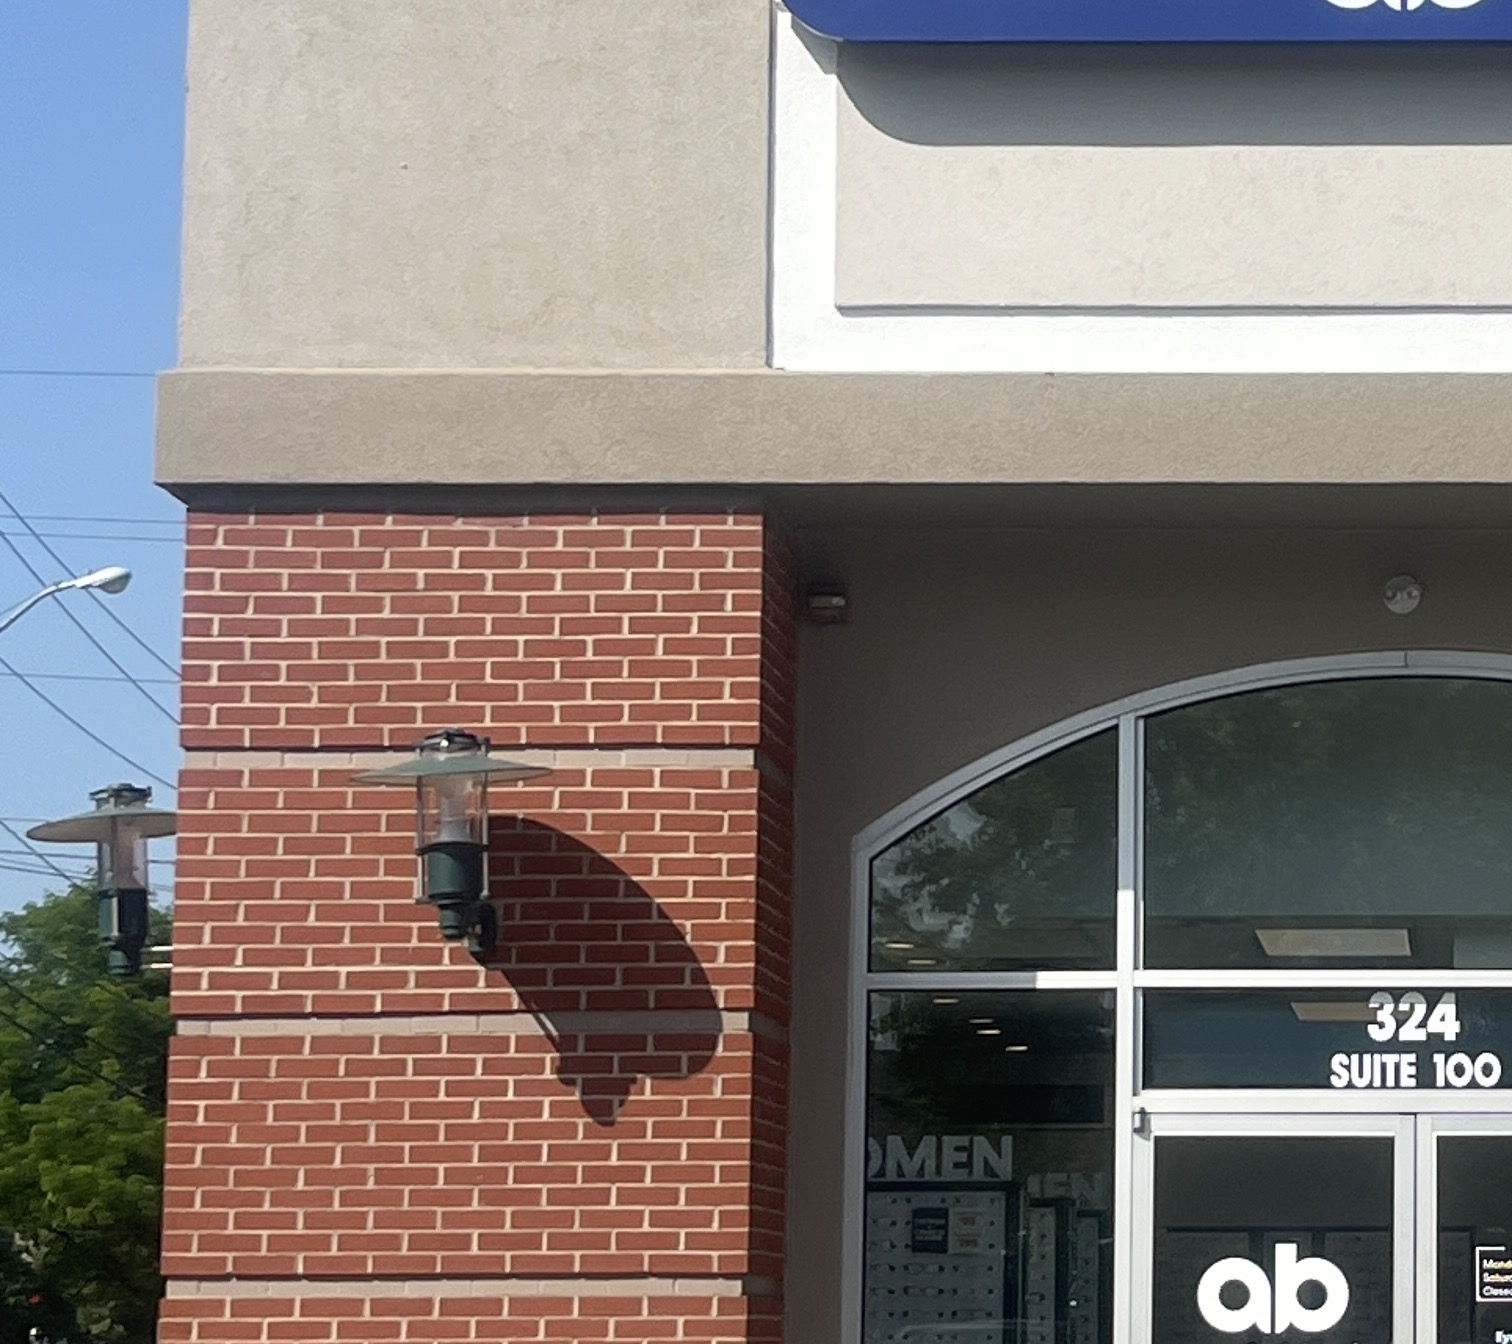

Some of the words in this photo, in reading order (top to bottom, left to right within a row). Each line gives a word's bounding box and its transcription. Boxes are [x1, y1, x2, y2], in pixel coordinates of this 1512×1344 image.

[1366, 991, 1461, 1042] 324
[1330, 1053, 1416, 1087] SUITE
[1433, 1053, 1501, 1087] 100
[1197, 1243, 1349, 1334] ab
